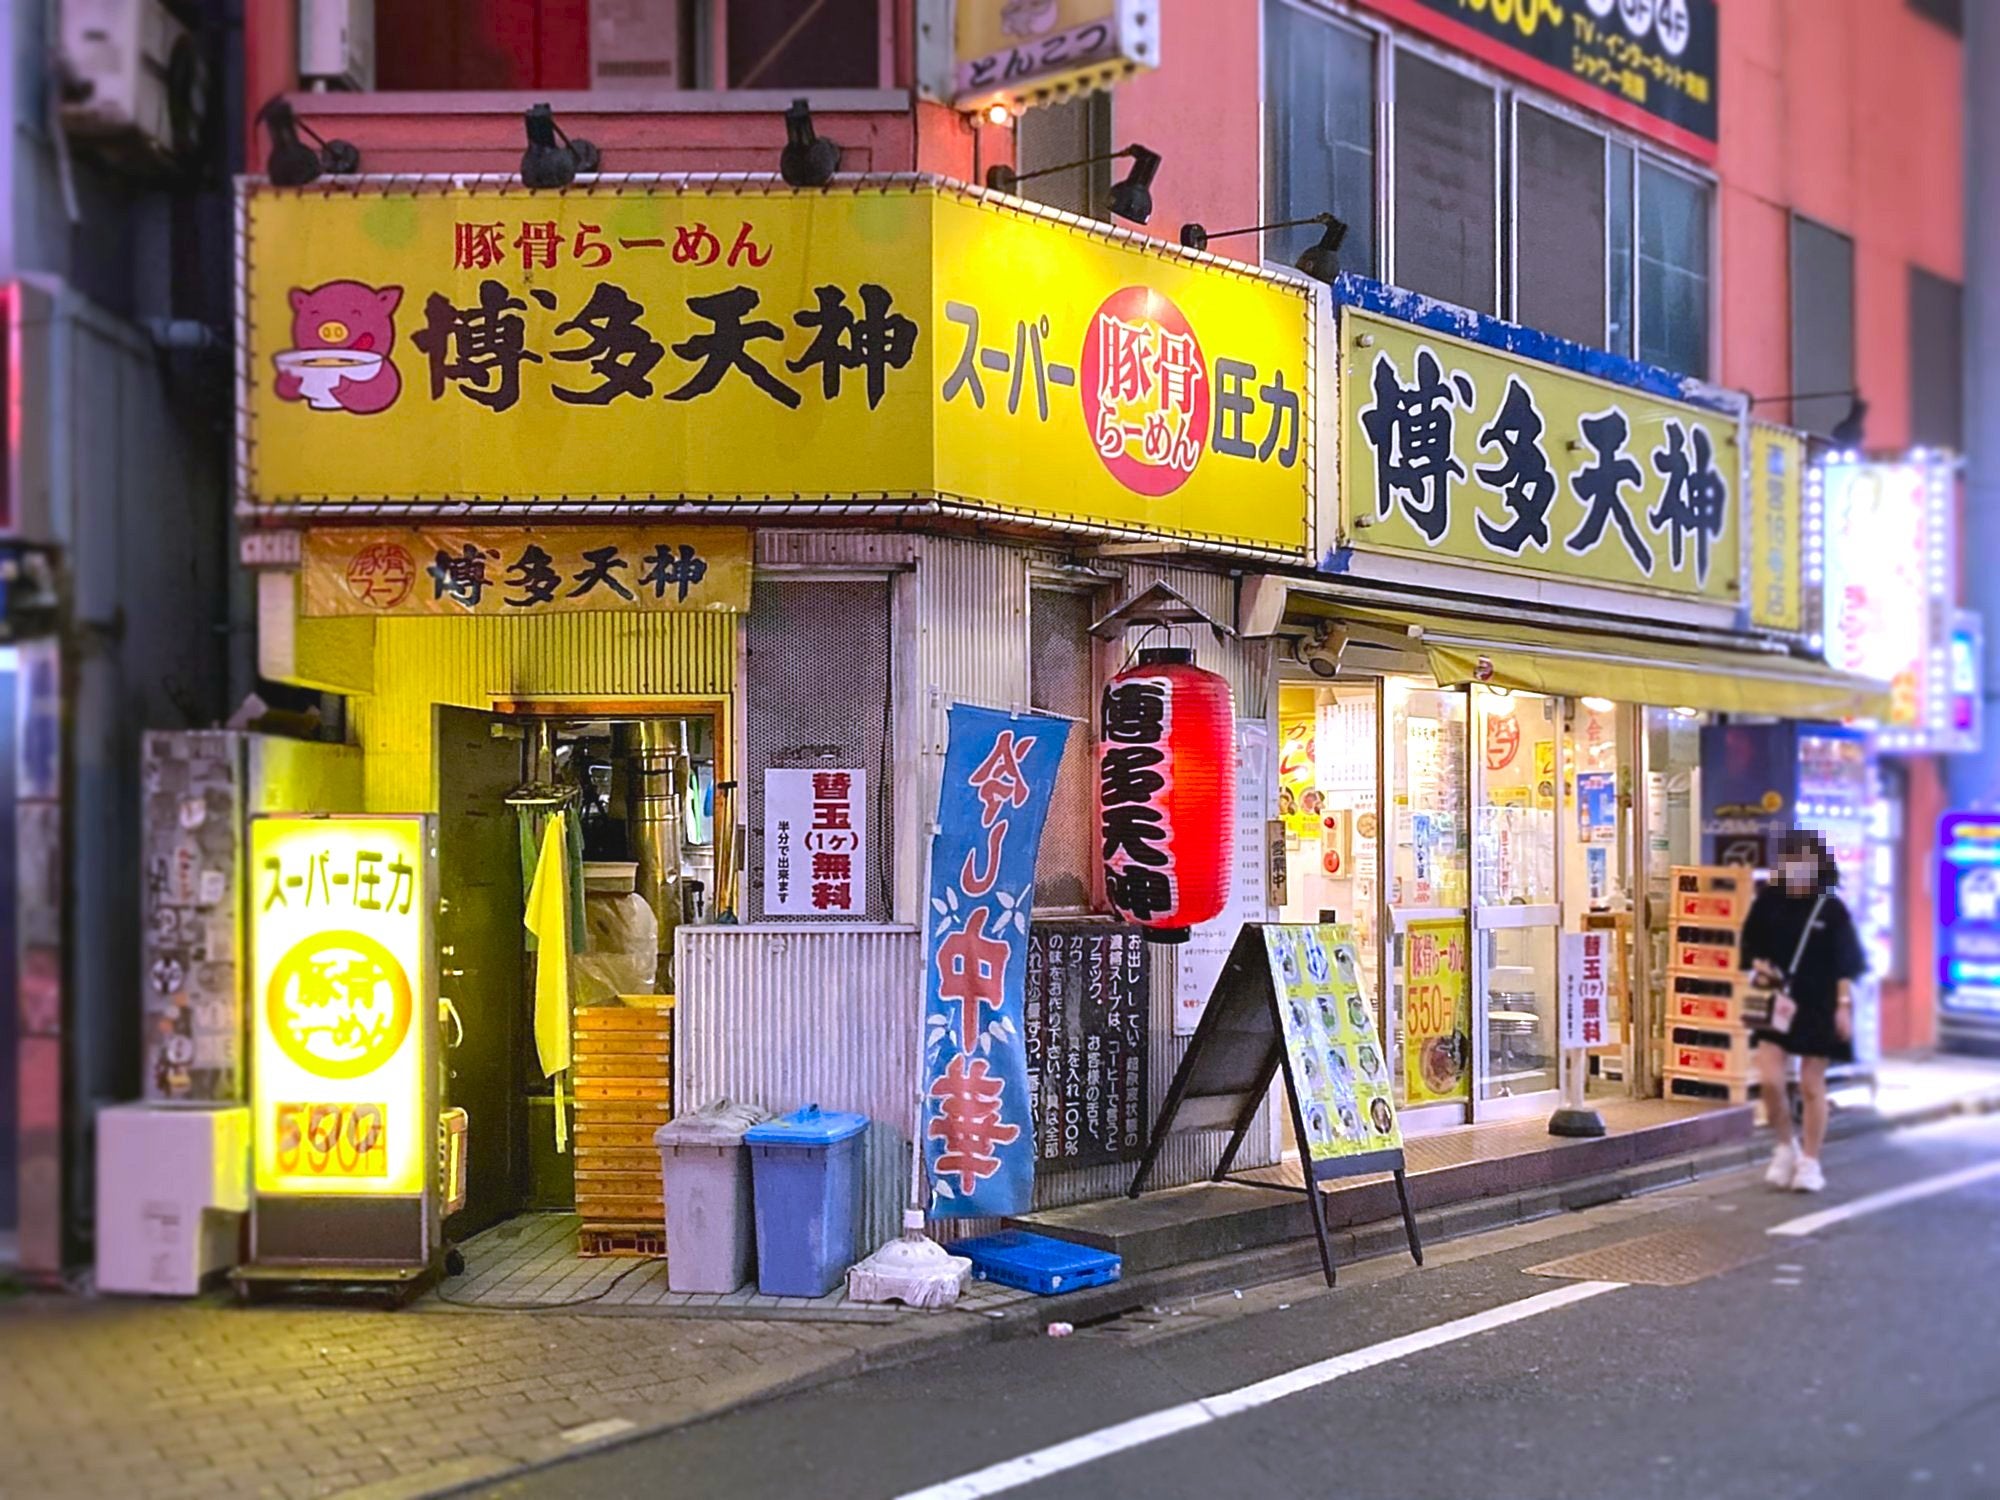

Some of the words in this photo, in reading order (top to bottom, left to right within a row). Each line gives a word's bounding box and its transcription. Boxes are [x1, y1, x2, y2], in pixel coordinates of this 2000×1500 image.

[970, 24, 1107, 88] とんこつ
[452, 221, 774, 272] 豚骨らーめん
[409, 279, 918, 412] 博多天神
[942, 300, 1076, 423] スーパー
[1211, 356, 1301, 469] 圧力
[1098, 313, 1201, 414] 豚骨
[1097, 400, 1201, 472] らーめん
[1359, 344, 1727, 587] 博多天神
[350, 570, 415, 607] スープ
[425, 543, 708, 607] 博多天神
[1101, 680, 1173, 920] 博多天神
[777, 820, 790, 904] 半分で出来ます
[1271, 839, 1287, 890] 営業中
[929, 729, 1037, 1196] 冷し中華
[1407, 984, 1453, 1035] 550円
